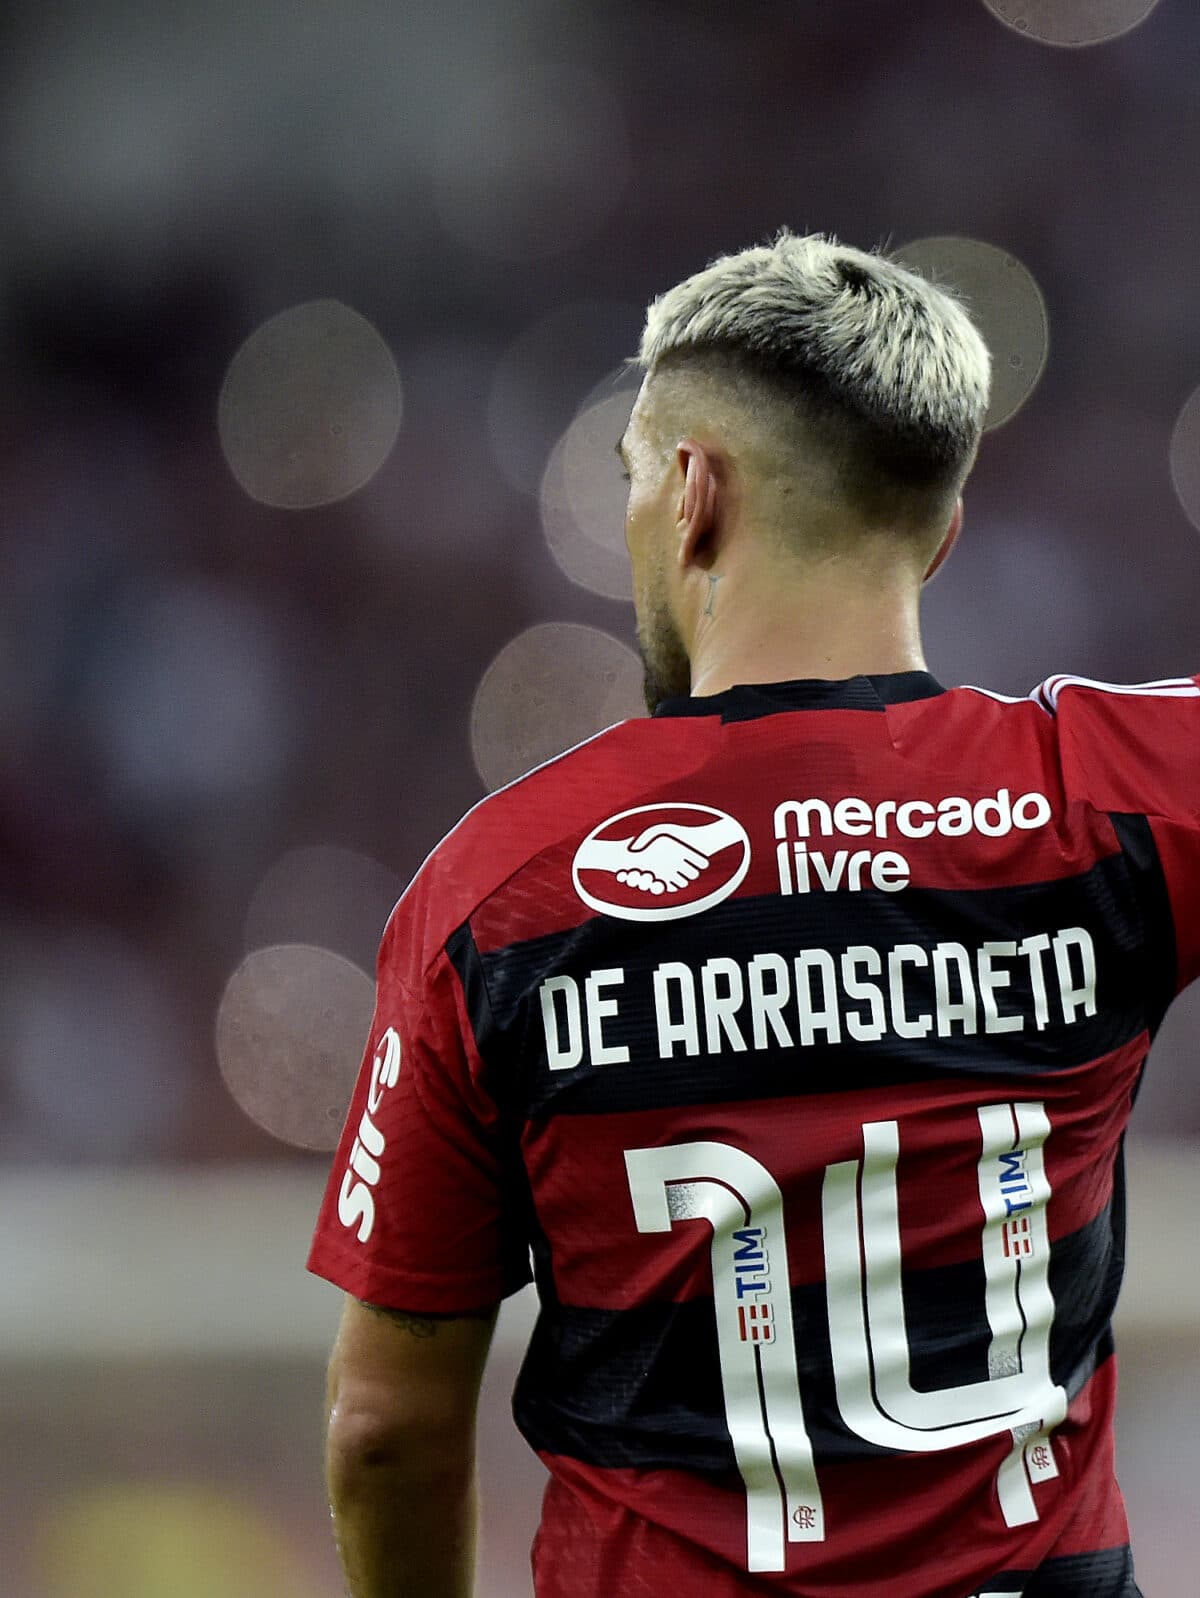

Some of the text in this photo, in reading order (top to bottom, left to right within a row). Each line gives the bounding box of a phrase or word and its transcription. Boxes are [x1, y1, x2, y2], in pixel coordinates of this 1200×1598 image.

[774, 788, 1051, 838] mercado
[776, 841, 910, 896] livre
[539, 926, 1097, 1071] DE ARRASCAETA
[997, 1149, 1033, 1218] TIM
[732, 1228, 767, 1299] TIM
[623, 1101, 1067, 1572] 14
